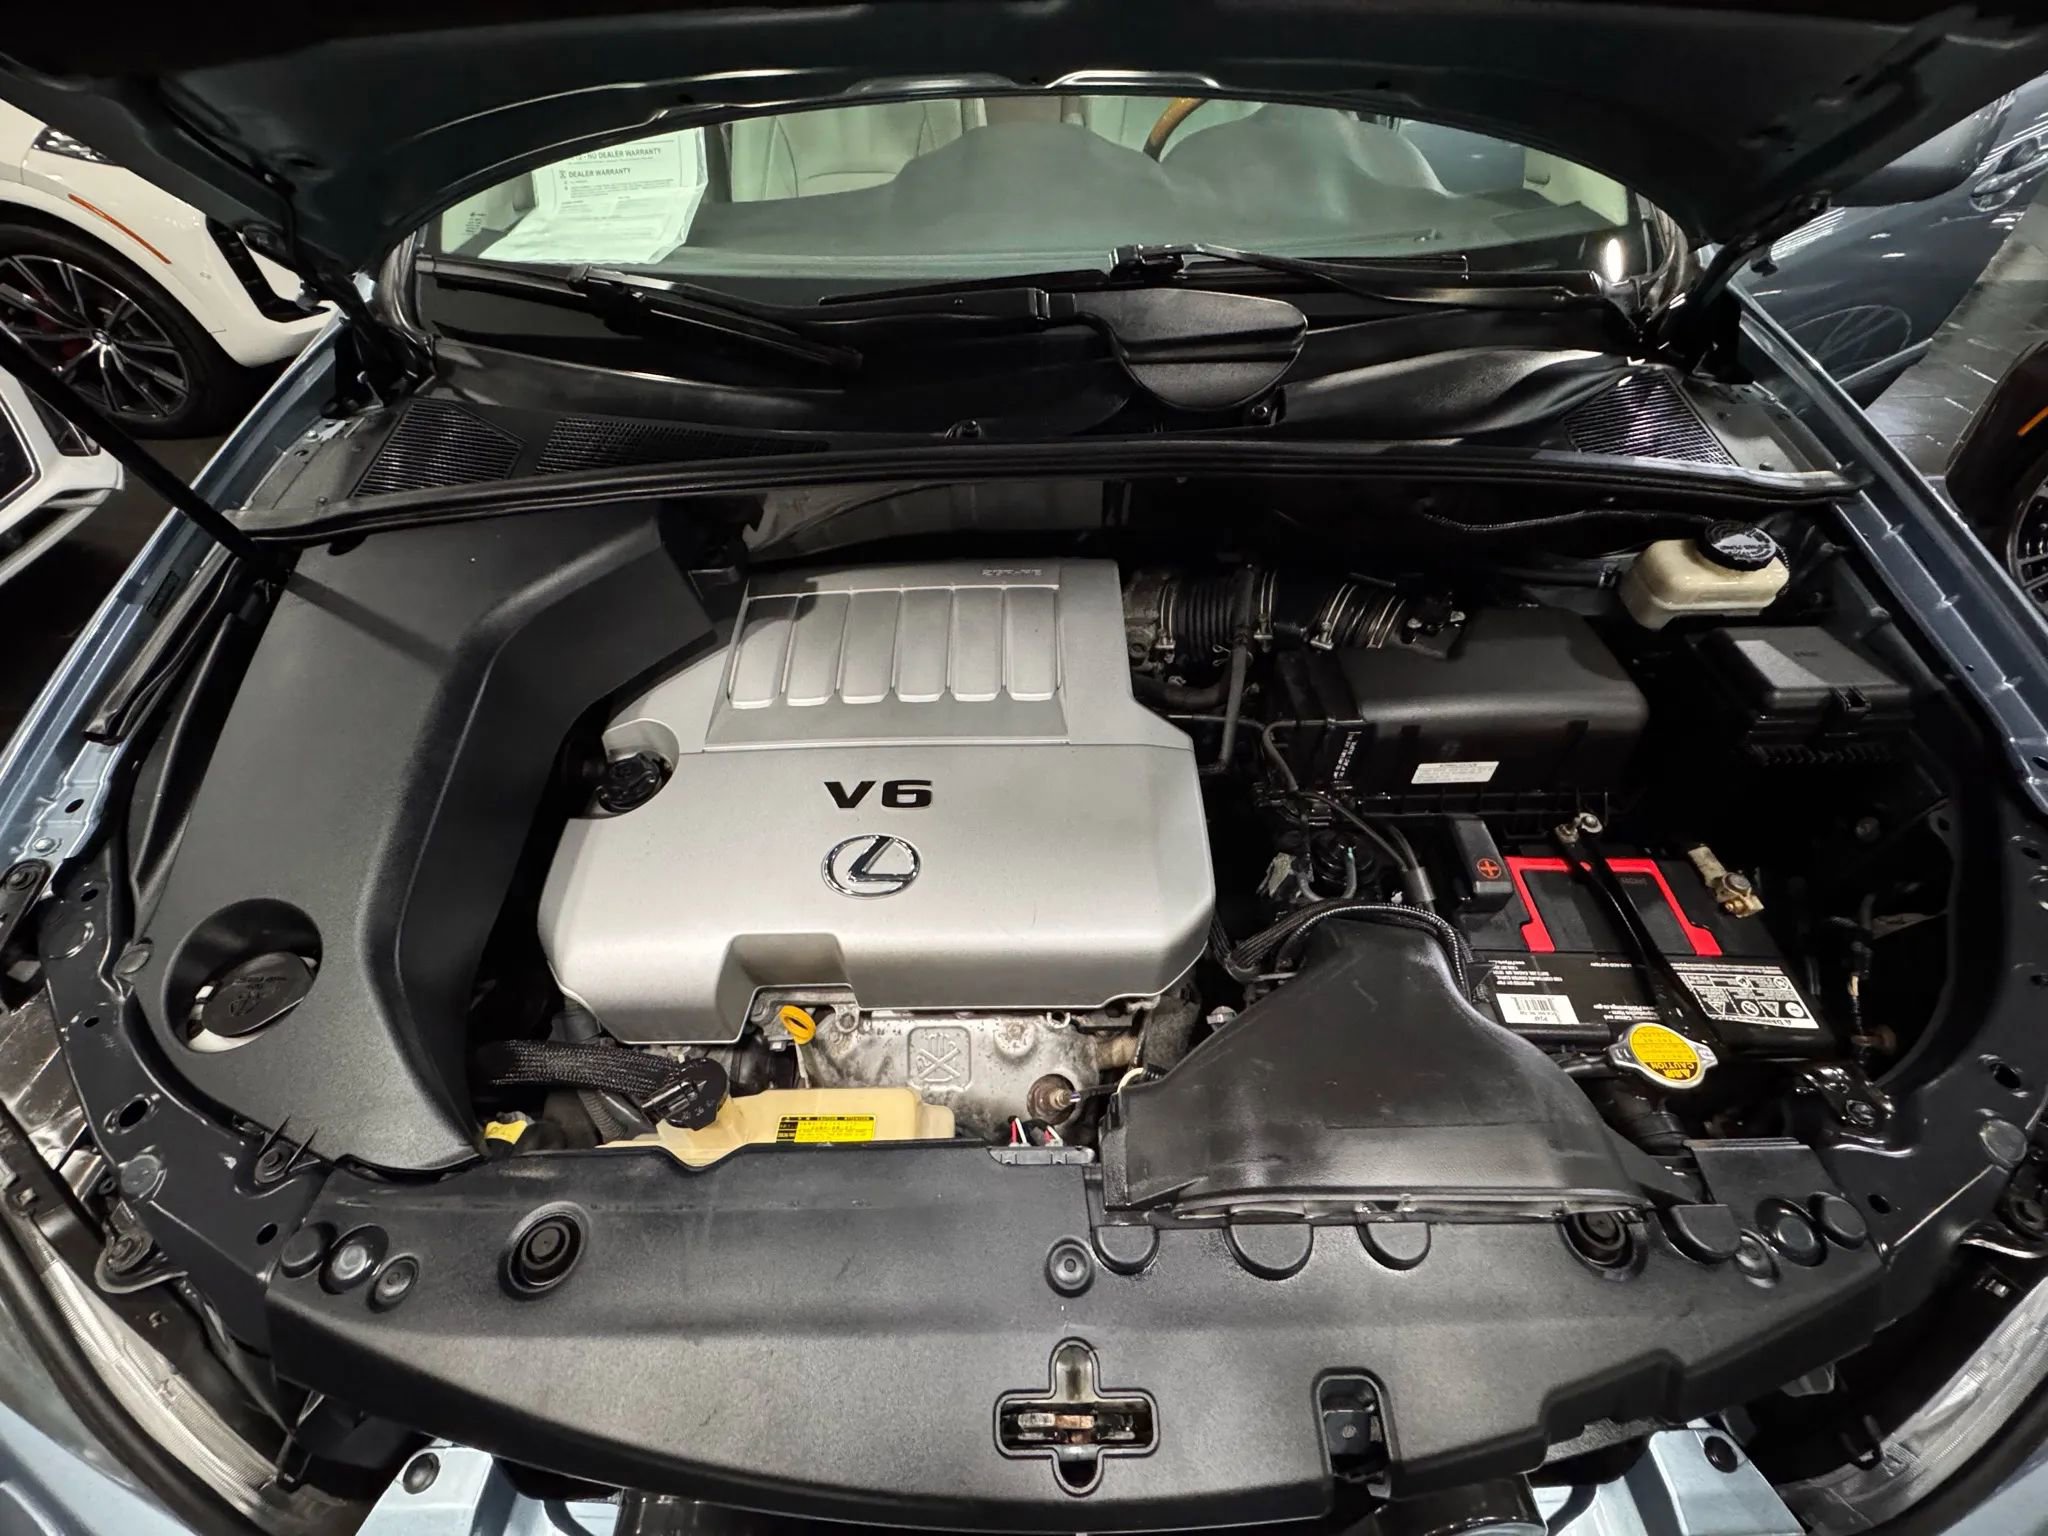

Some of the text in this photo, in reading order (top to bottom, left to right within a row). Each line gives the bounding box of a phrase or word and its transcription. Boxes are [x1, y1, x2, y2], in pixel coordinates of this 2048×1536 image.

[599, 149, 624, 159] DEALER
[625, 147, 661, 158] WARRANTY
[568, 167, 631, 178] DEALER WARRANTY
[824, 779, 932, 809] V6
[1650, 1061, 1695, 1070] CAUTION
